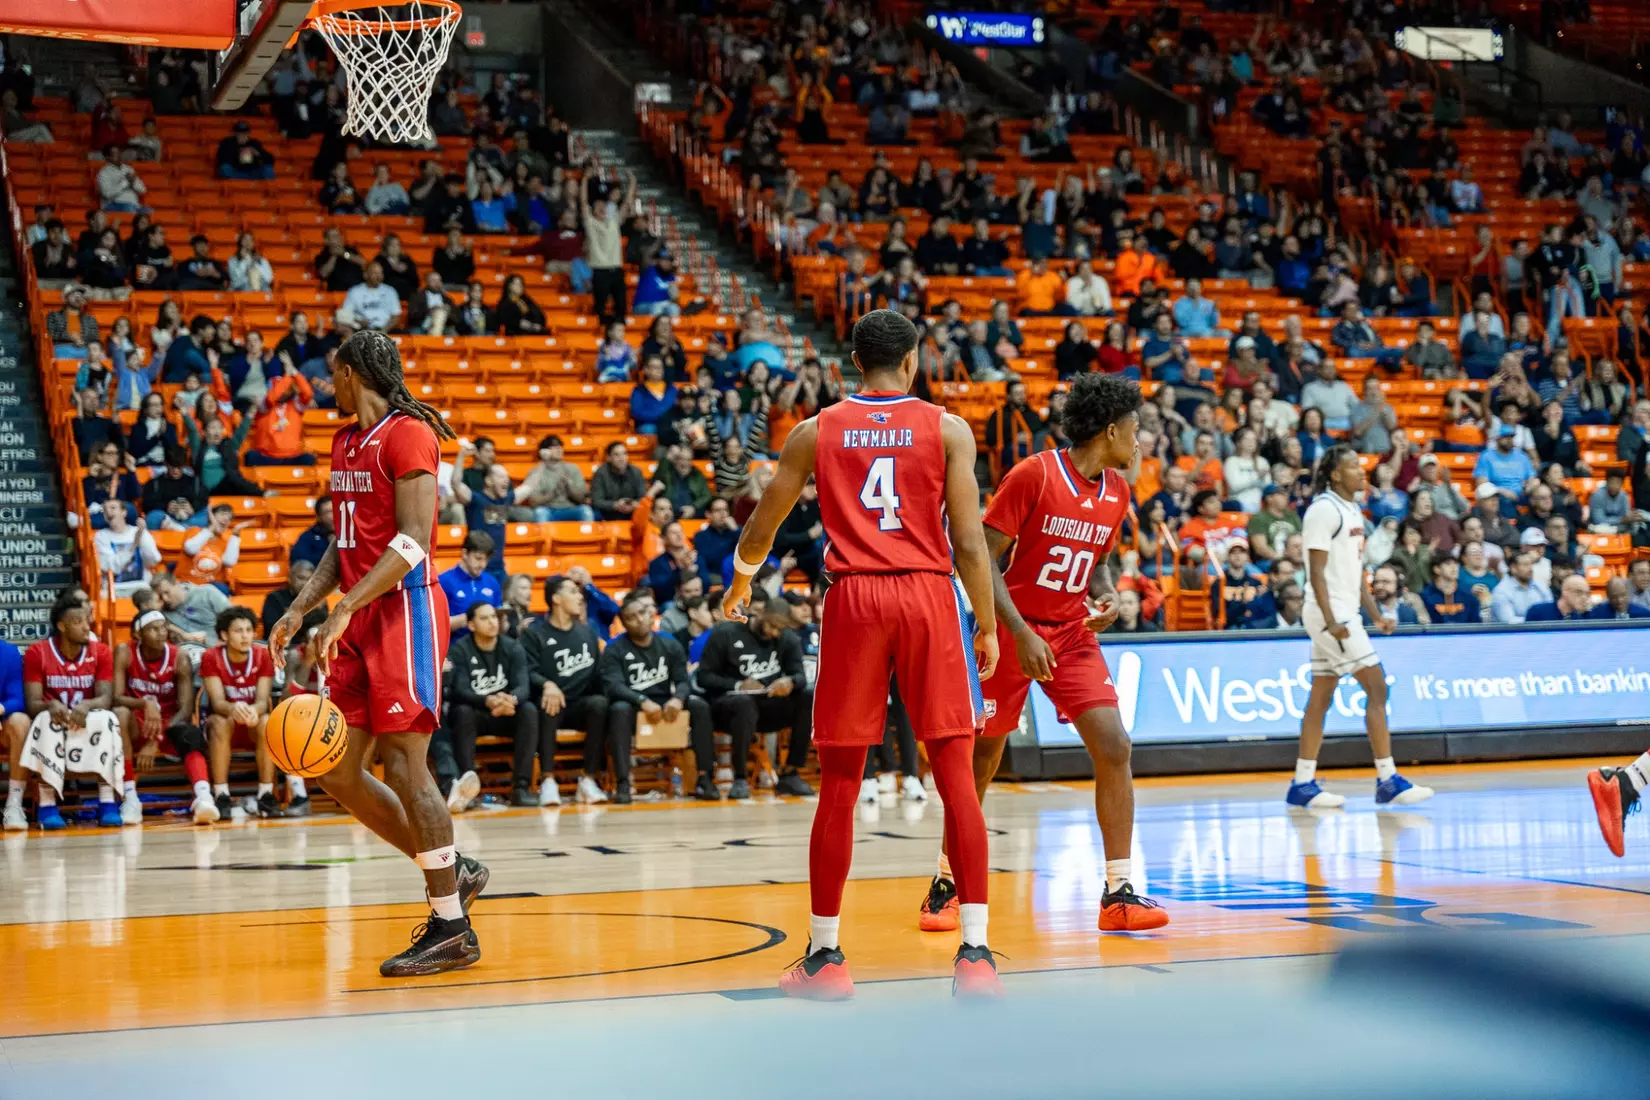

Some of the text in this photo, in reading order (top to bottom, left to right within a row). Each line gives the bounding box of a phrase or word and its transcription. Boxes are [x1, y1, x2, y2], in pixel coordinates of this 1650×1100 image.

[859, 456, 904, 532] 4
[1041, 514, 1094, 543] LOUISIANA
[0, 554, 63, 568] THLETICS
[1036, 545, 1094, 593] 20
[0, 572, 38, 587] ECU
[1413, 673, 1449, 700] It's
[1452, 676, 1517, 699] more
[1519, 670, 1573, 696] than
[320, 707, 339, 745] NCAA
